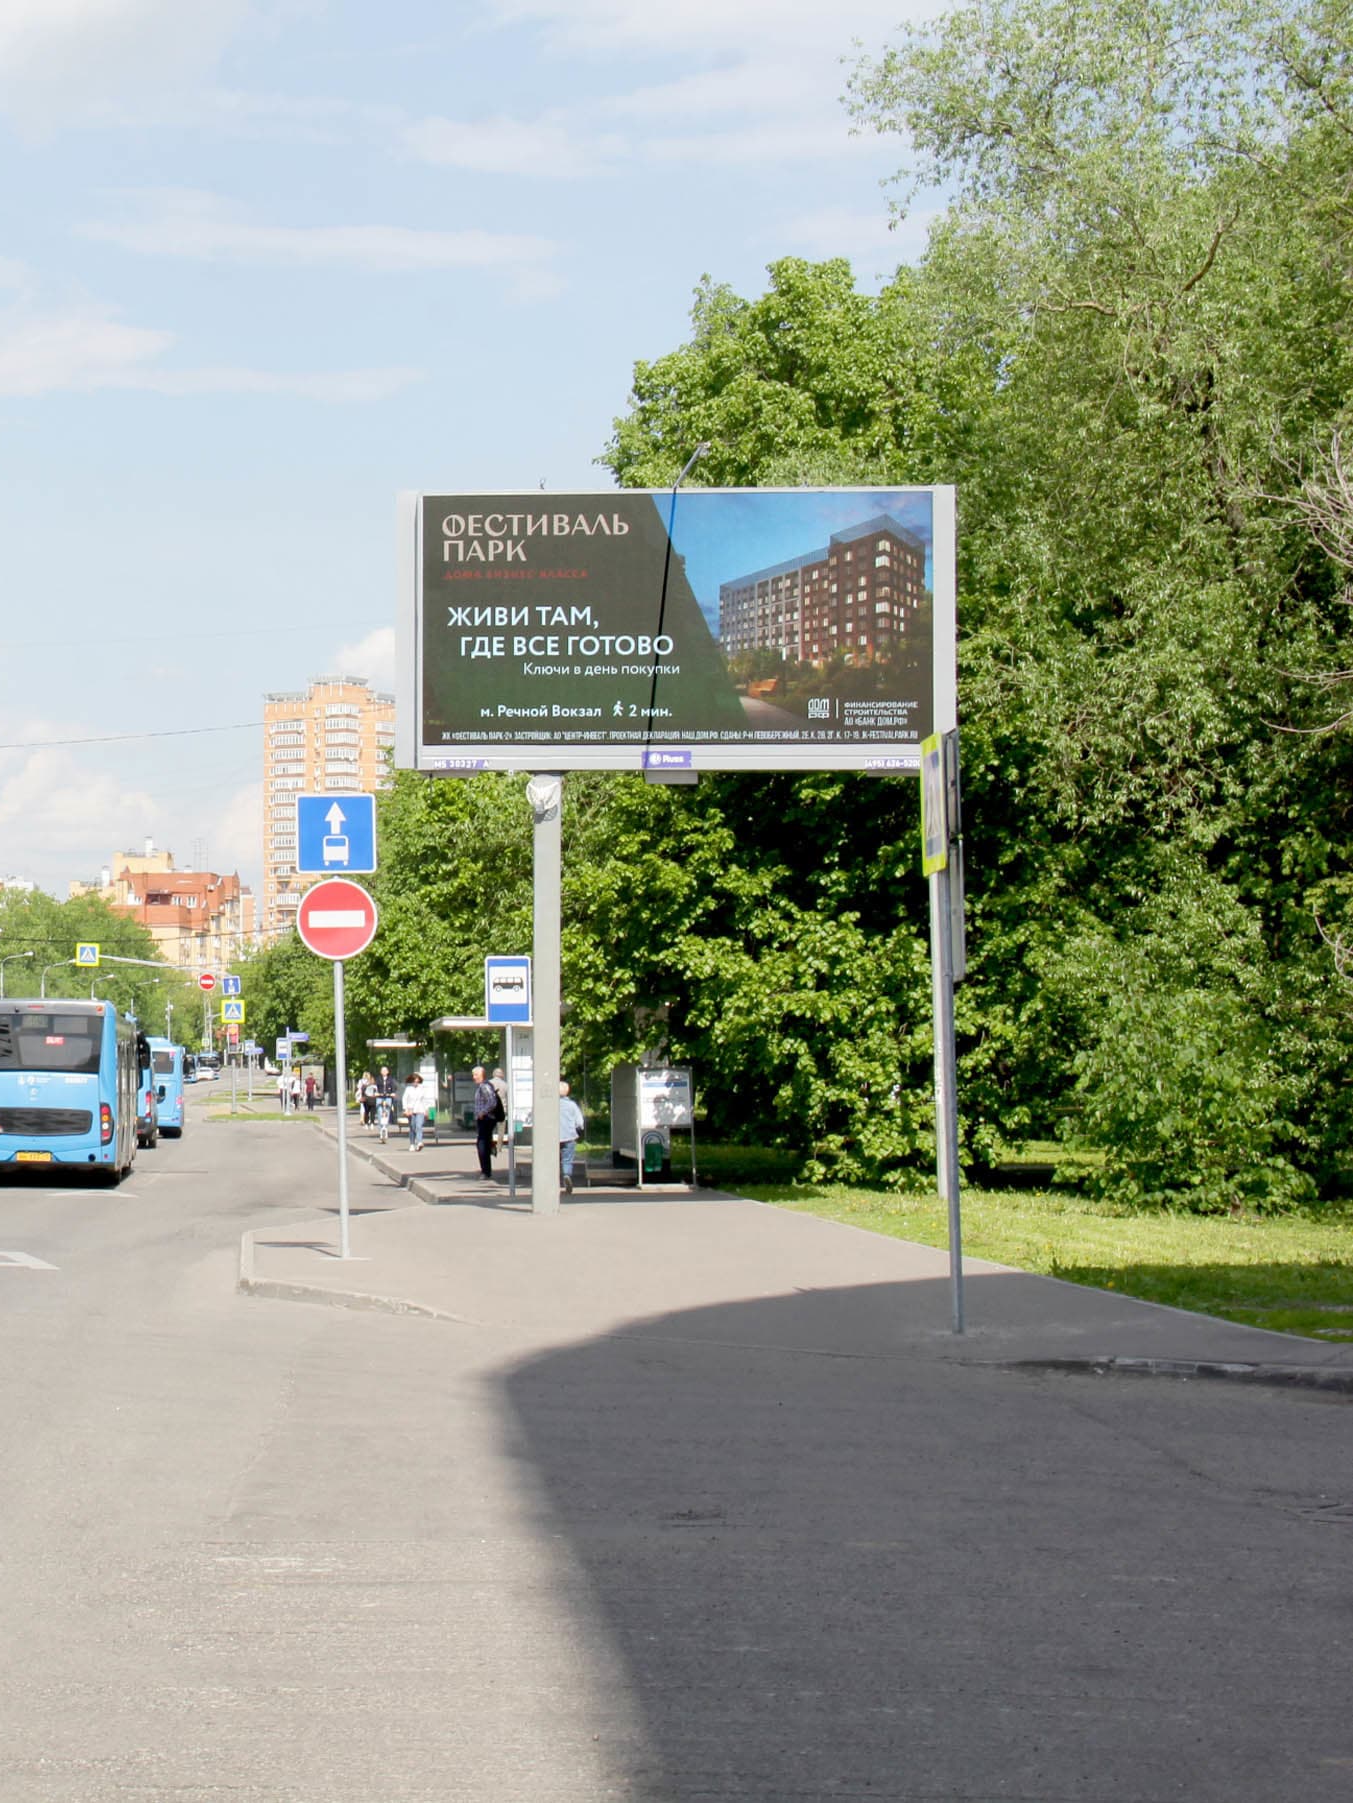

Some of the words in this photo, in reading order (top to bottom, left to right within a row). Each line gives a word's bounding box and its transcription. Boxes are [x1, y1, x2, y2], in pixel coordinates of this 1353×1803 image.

[441, 513, 630, 537] ФЕСТИВАЛЬ
[443, 539, 528, 562] ПАРК
[447, 606, 529, 626] ЖИВИ
[535, 606, 599, 629] ТАМ,
[460, 636, 505, 659] ГДЕ
[513, 636, 560, 656] ВСЕ
[567, 635, 674, 656] ГОТОВО
[523, 662, 570, 675] Ключи
[573, 665, 581, 675] в
[584, 665, 618, 677] день
[621, 664, 681, 677] покупки
[480, 707, 494, 718] м.
[497, 704, 548, 718] Речной
[552, 705, 602, 718] Вокзал
[629, 704, 637, 717] 2
[641, 707, 673, 717] мин.
[844, 708, 908, 716] СТРОИТЕЛЬСТВА
